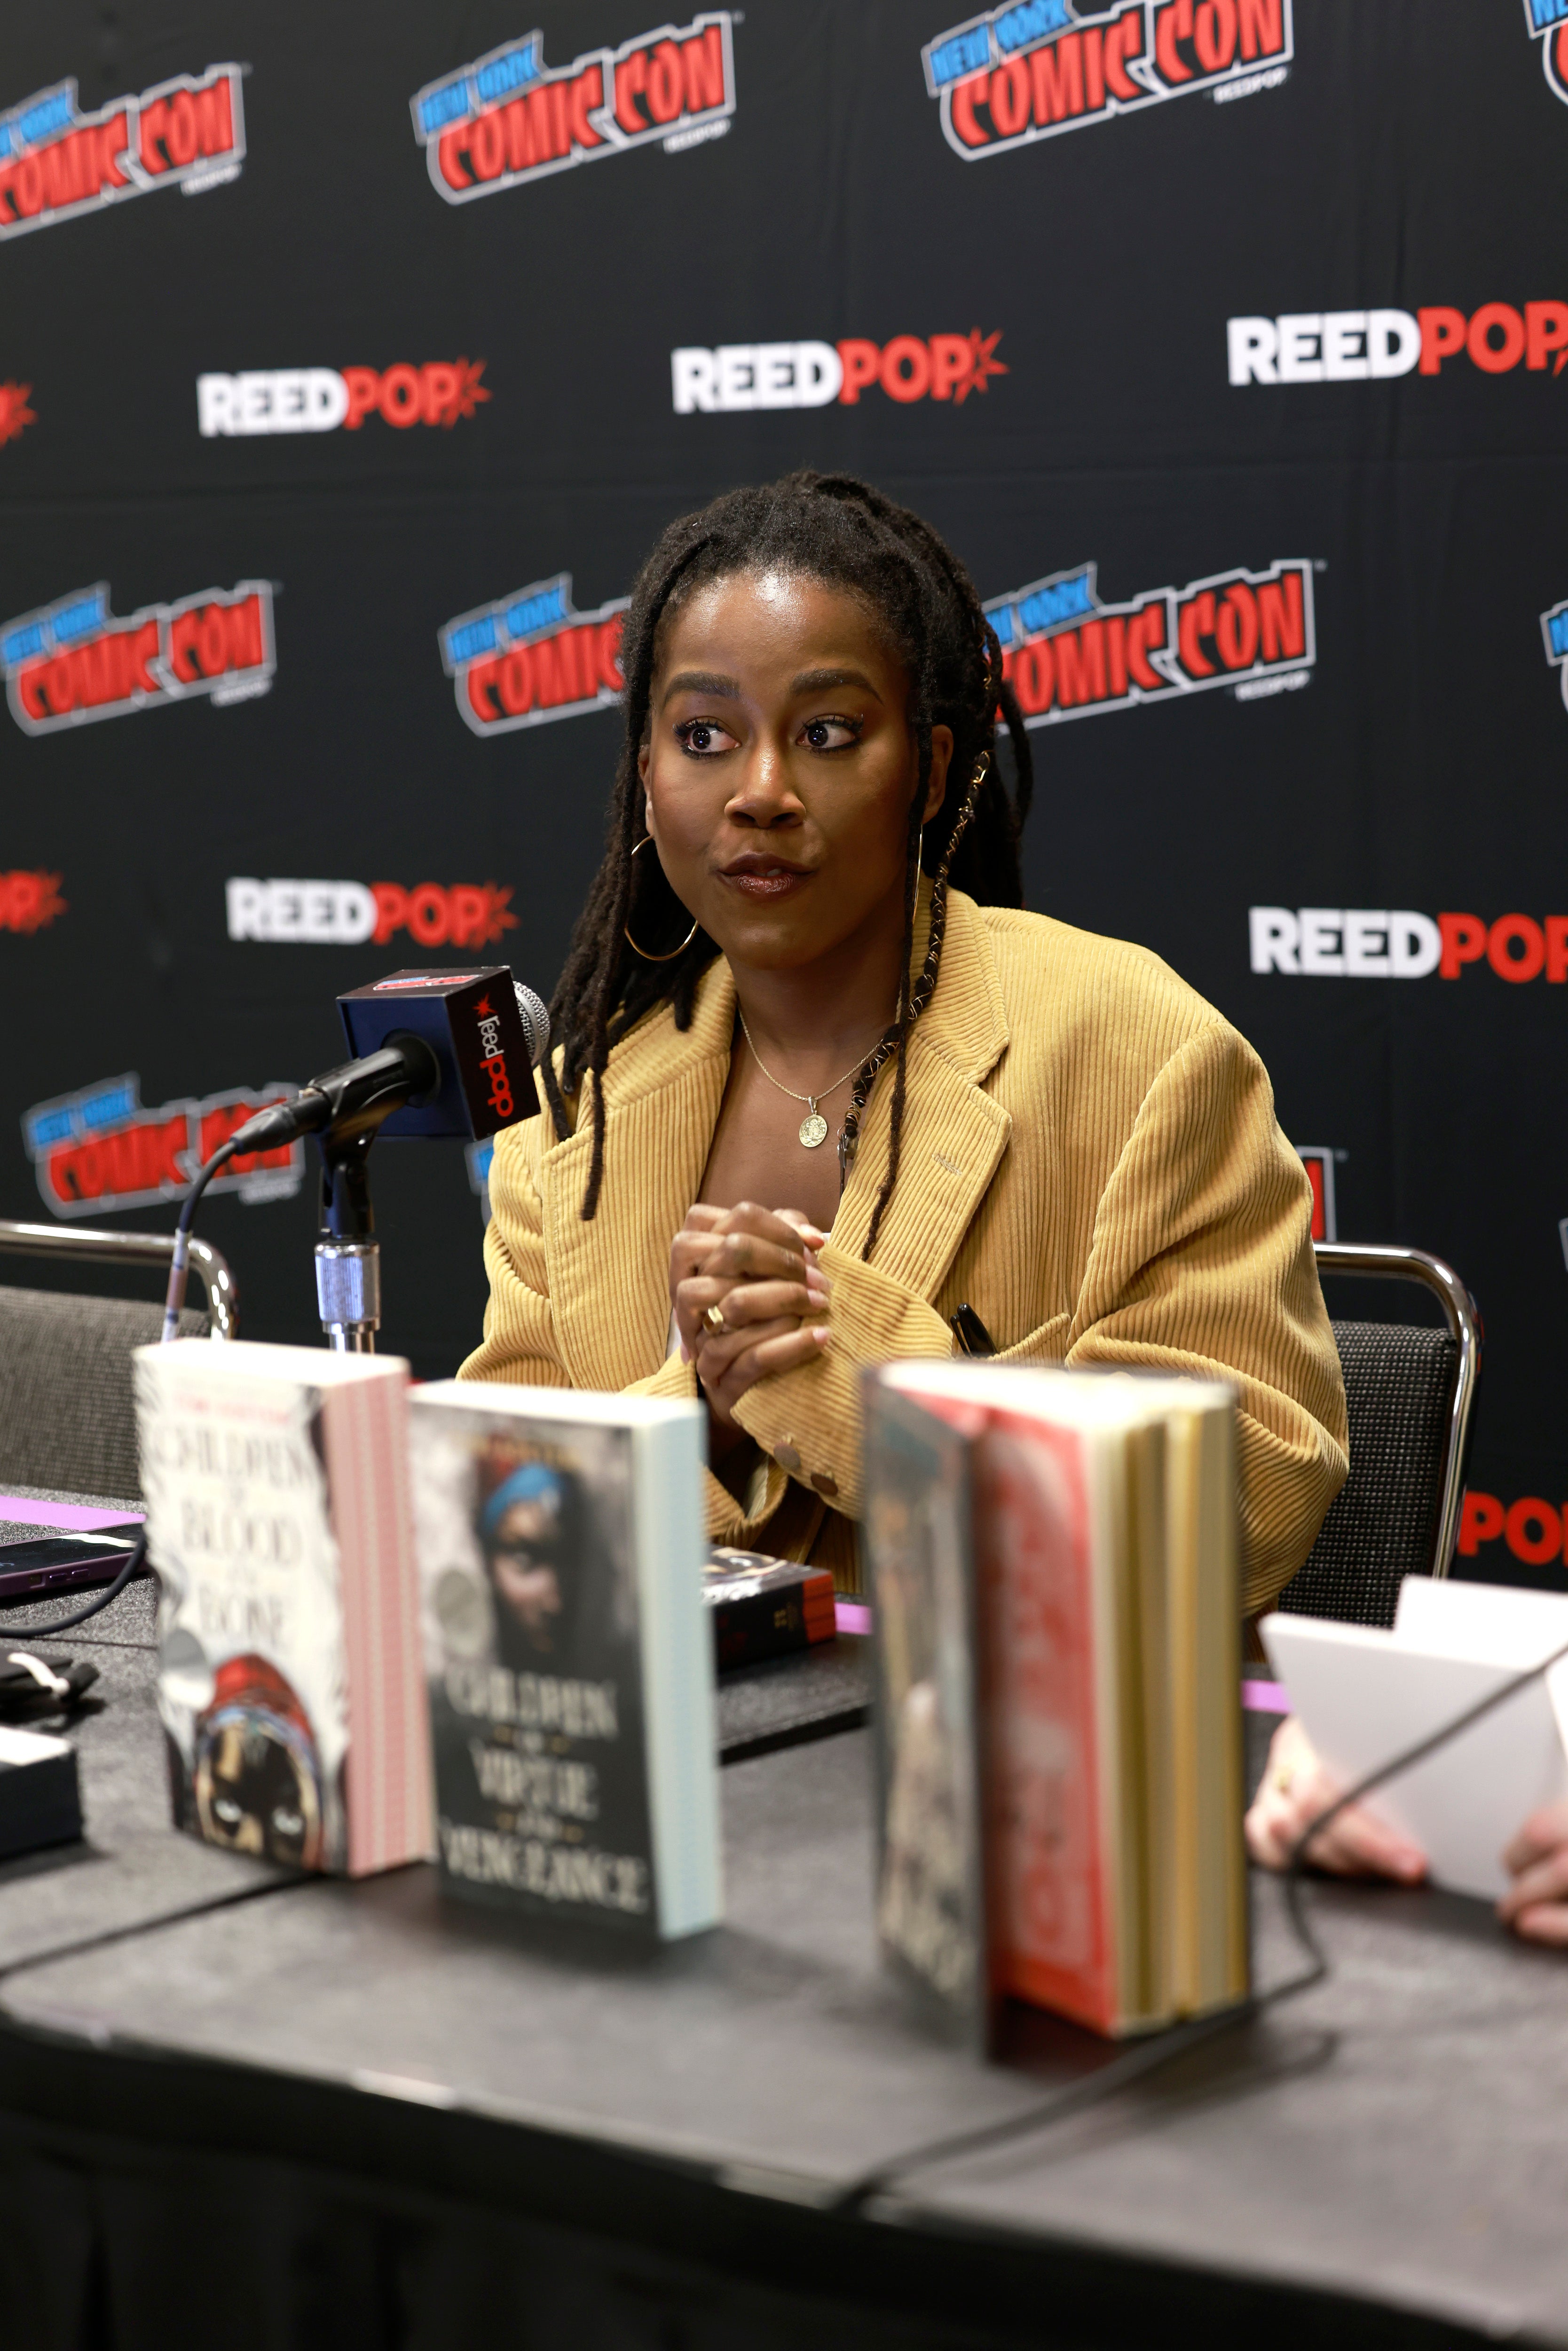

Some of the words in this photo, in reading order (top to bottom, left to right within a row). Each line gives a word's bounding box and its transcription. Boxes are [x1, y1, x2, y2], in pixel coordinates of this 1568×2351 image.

[437, 65, 603, 190] COMIC
[614, 25, 725, 133] CON
[951, 10, 1142, 146] COMIC
[1155, 0, 1283, 83] CON
[138, 76, 235, 175] CON
[671, 333, 976, 414] REEDPOP
[1227, 300, 1568, 386] REEDPOP
[197, 362, 461, 437] REEDPOP
[18, 619, 159, 721] COMIC
[170, 593, 265, 684] CON
[466, 611, 625, 723] COMIC
[1178, 573, 1305, 677] CON
[226, 876, 489, 947] REEDPOP
[477, 1015, 514, 1117] reedpop
